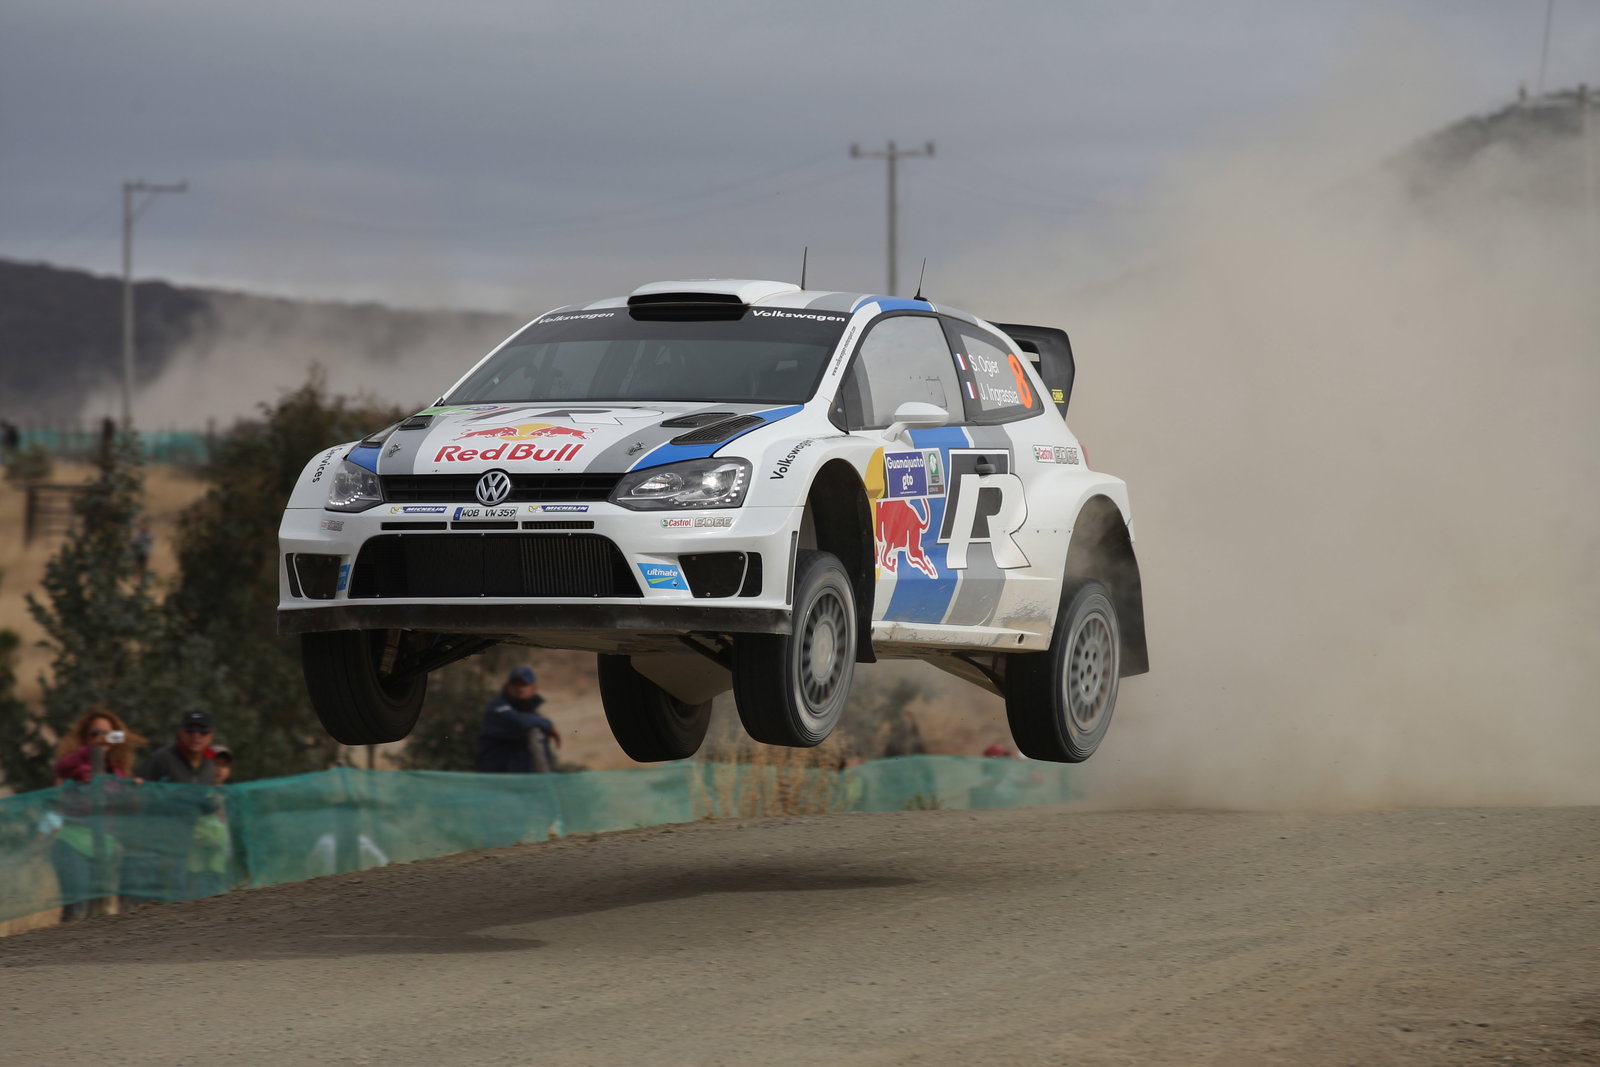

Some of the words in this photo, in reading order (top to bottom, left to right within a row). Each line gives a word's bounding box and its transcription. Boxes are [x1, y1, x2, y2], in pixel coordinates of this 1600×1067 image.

[538, 312, 615, 324] Volkswagen
[752, 309, 846, 322] Volkswagen
[968, 353, 980, 372] S.
[978, 354, 1000, 378] Ogier
[1007, 353, 1033, 409] 8
[986, 383, 1020, 406] Ingrassia
[433, 443, 510, 463] Red
[507, 443, 585, 462] Bull
[1053, 446, 1080, 465] EDGE
[886, 456, 924, 472] Guanajuato
[461, 509, 480, 517] WOB
[484, 509, 498, 517] VW
[497, 509, 516, 517] 359
[694, 517, 733, 527] EDGE
[647, 568, 678, 577] ultimate
